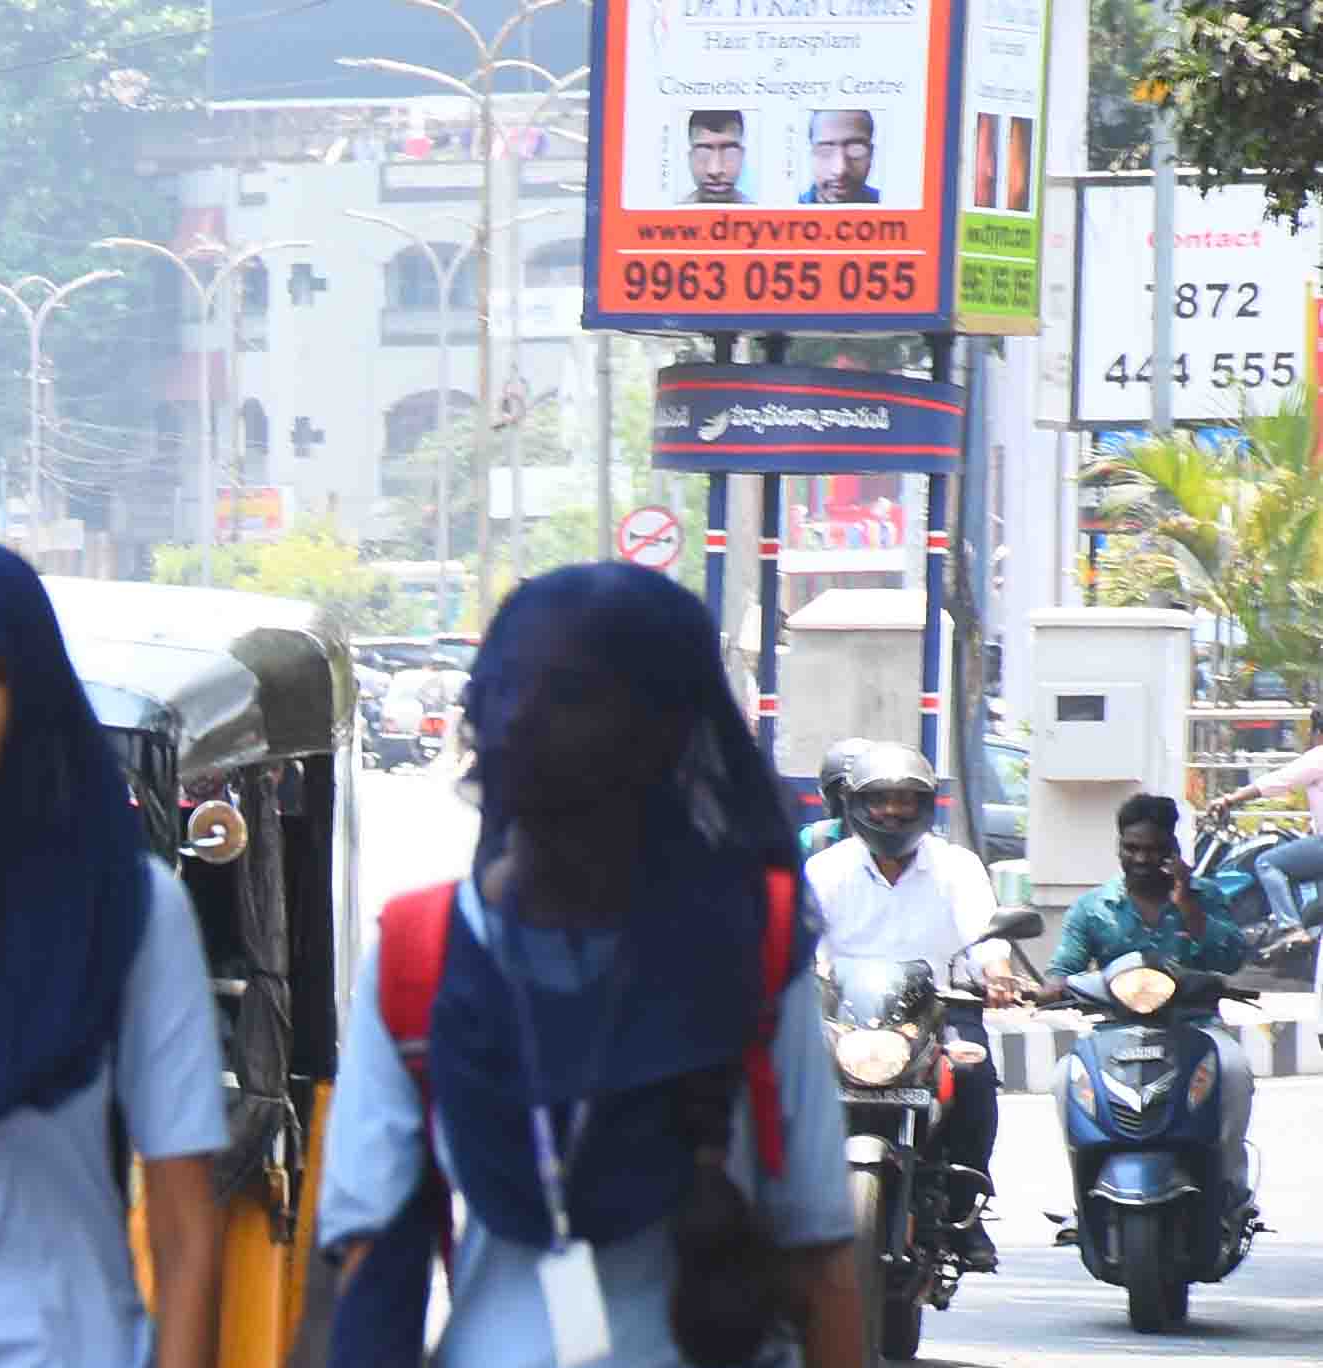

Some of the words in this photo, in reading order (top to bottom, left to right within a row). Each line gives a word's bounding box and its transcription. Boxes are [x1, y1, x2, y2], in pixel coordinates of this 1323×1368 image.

[704, 32, 750, 50] Hair
[755, 31, 862, 55] Transplant
[658, 75, 751, 97] Cosmetic
[754, 75, 832, 102] Surgery
[838, 75, 907, 97] Centre
[637, 213, 909, 249] www.dryvro.com
[623, 260, 727, 301] 9963
[744, 260, 822, 301] 055
[839, 260, 917, 301] 055
[1210, 352, 1295, 388] 555
